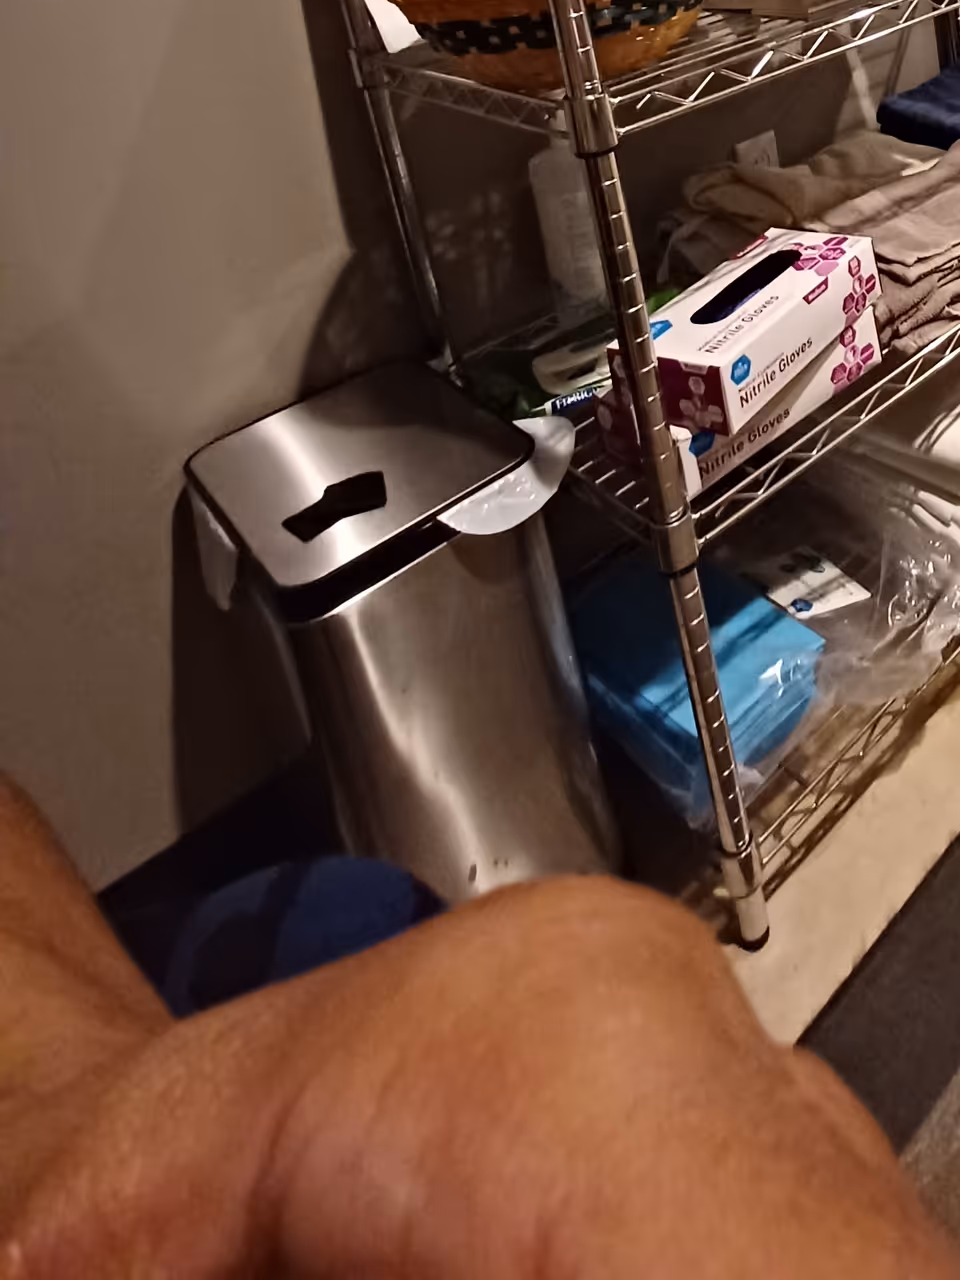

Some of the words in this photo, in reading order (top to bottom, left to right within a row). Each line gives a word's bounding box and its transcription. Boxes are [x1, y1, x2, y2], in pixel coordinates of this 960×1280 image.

[704, 323, 745, 354] Nitrile
[741, 295, 780, 323] Gloves
[739, 368, 777, 409] Nitrile
[778, 336, 813, 373] Gloves
[699, 440, 745, 480] Nitrile
[747, 408, 791, 443] Gloves
